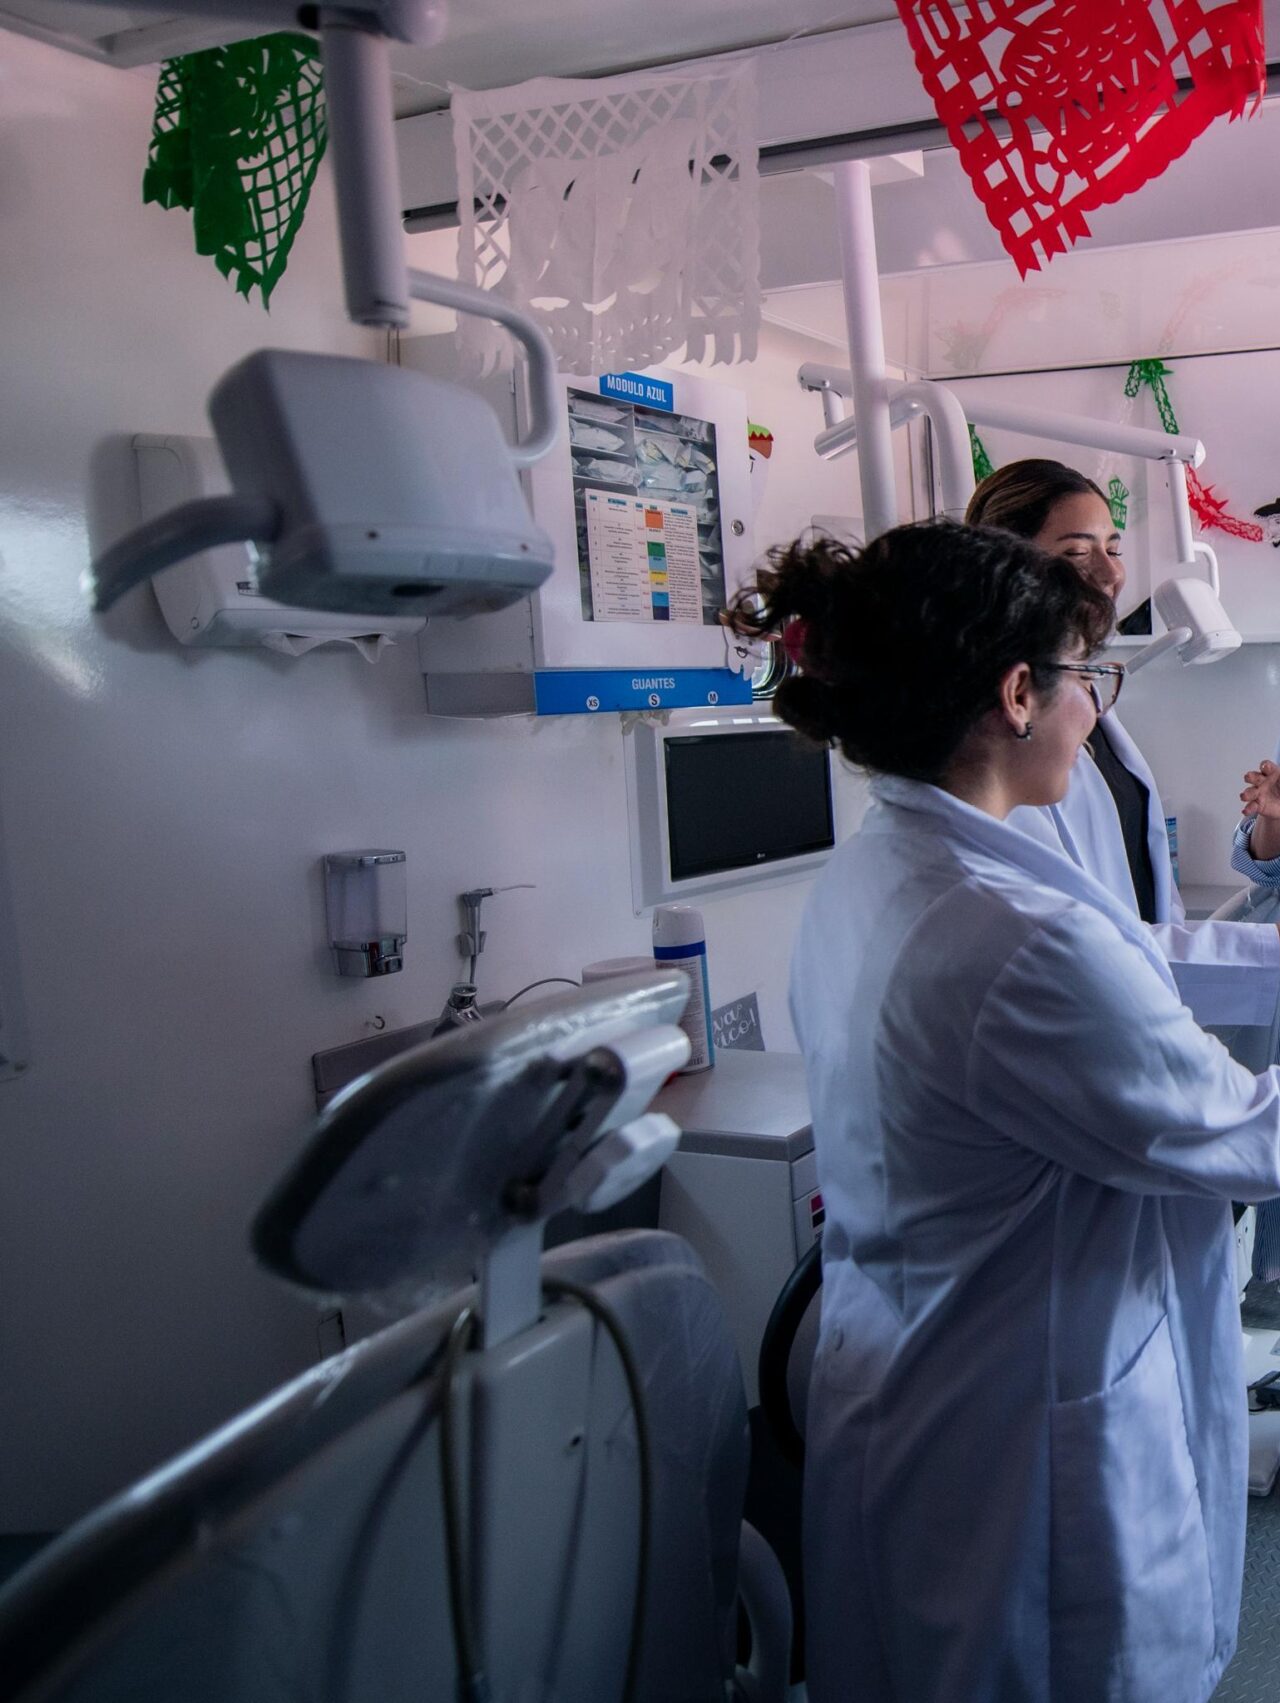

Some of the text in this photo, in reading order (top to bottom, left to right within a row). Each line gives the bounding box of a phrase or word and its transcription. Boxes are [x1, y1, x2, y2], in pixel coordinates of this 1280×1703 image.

[607, 375, 667, 403] MODULO AZUL
[631, 677, 676, 690] GUANTES
[588, 699, 598, 707] XS
[650, 695, 658, 706] S
[709, 694, 717, 702] M
